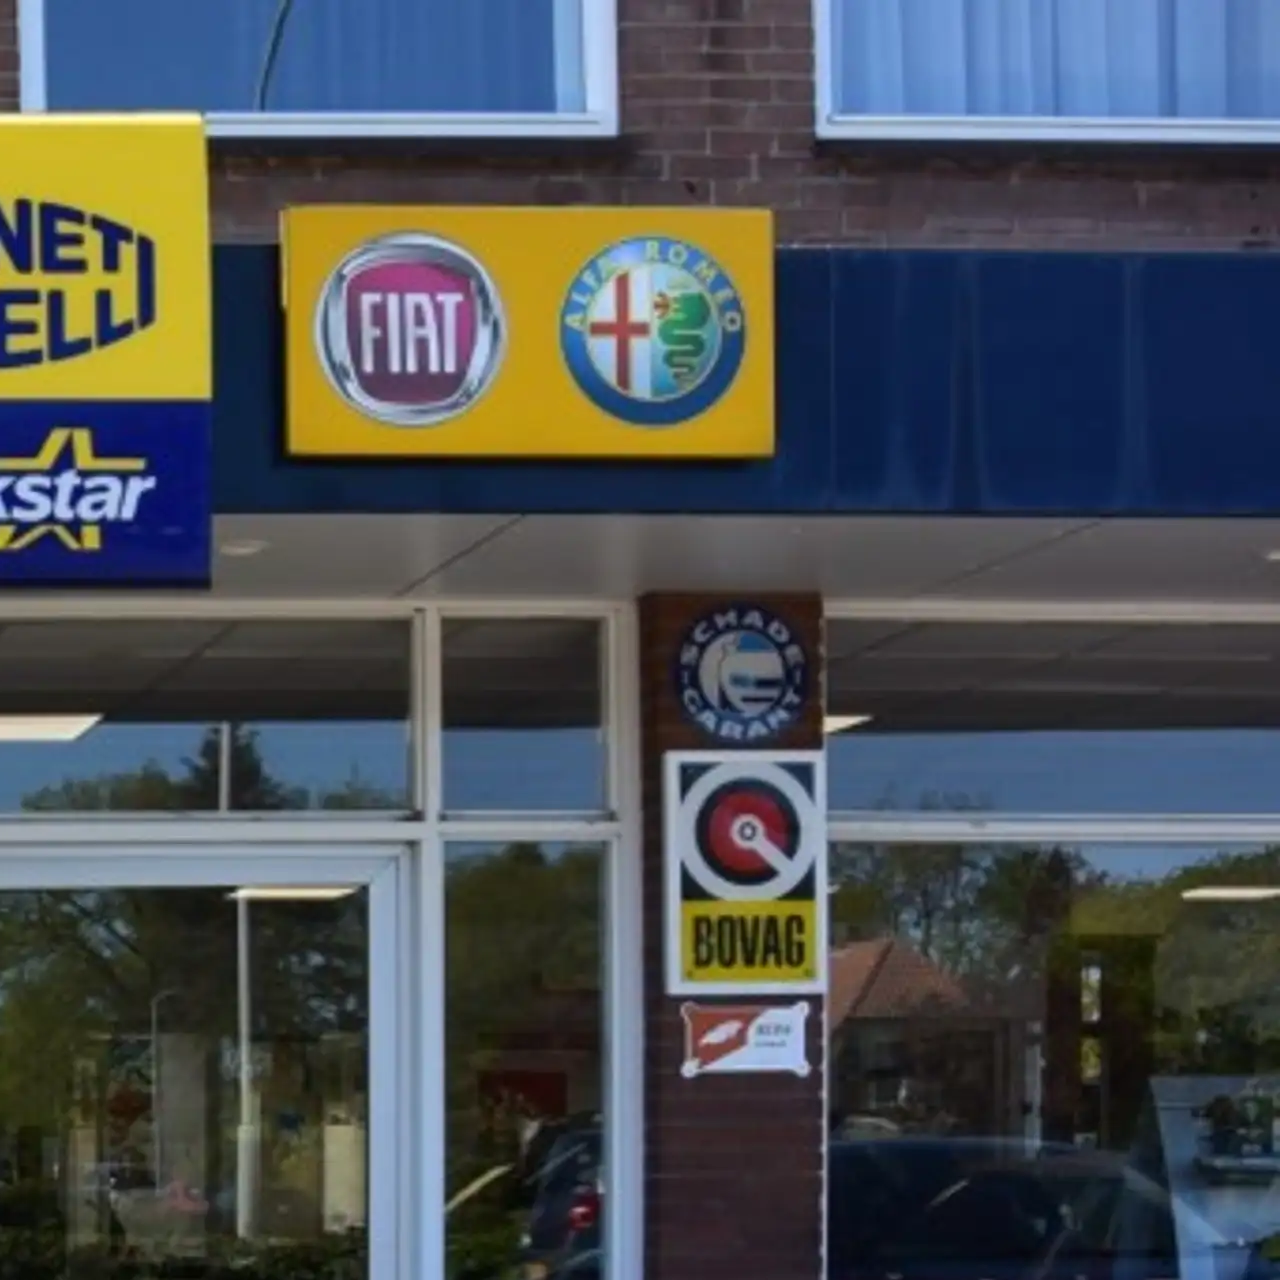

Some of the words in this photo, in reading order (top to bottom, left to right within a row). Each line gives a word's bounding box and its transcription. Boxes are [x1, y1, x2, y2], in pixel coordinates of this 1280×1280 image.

[564, 256, 620, 332] ALFA
[645, 238, 742, 333] ROMEO
[359, 292, 464, 374] FIAT
[679, 608, 805, 666] SCHADE
[692, 914, 807, 969] BOVAG
